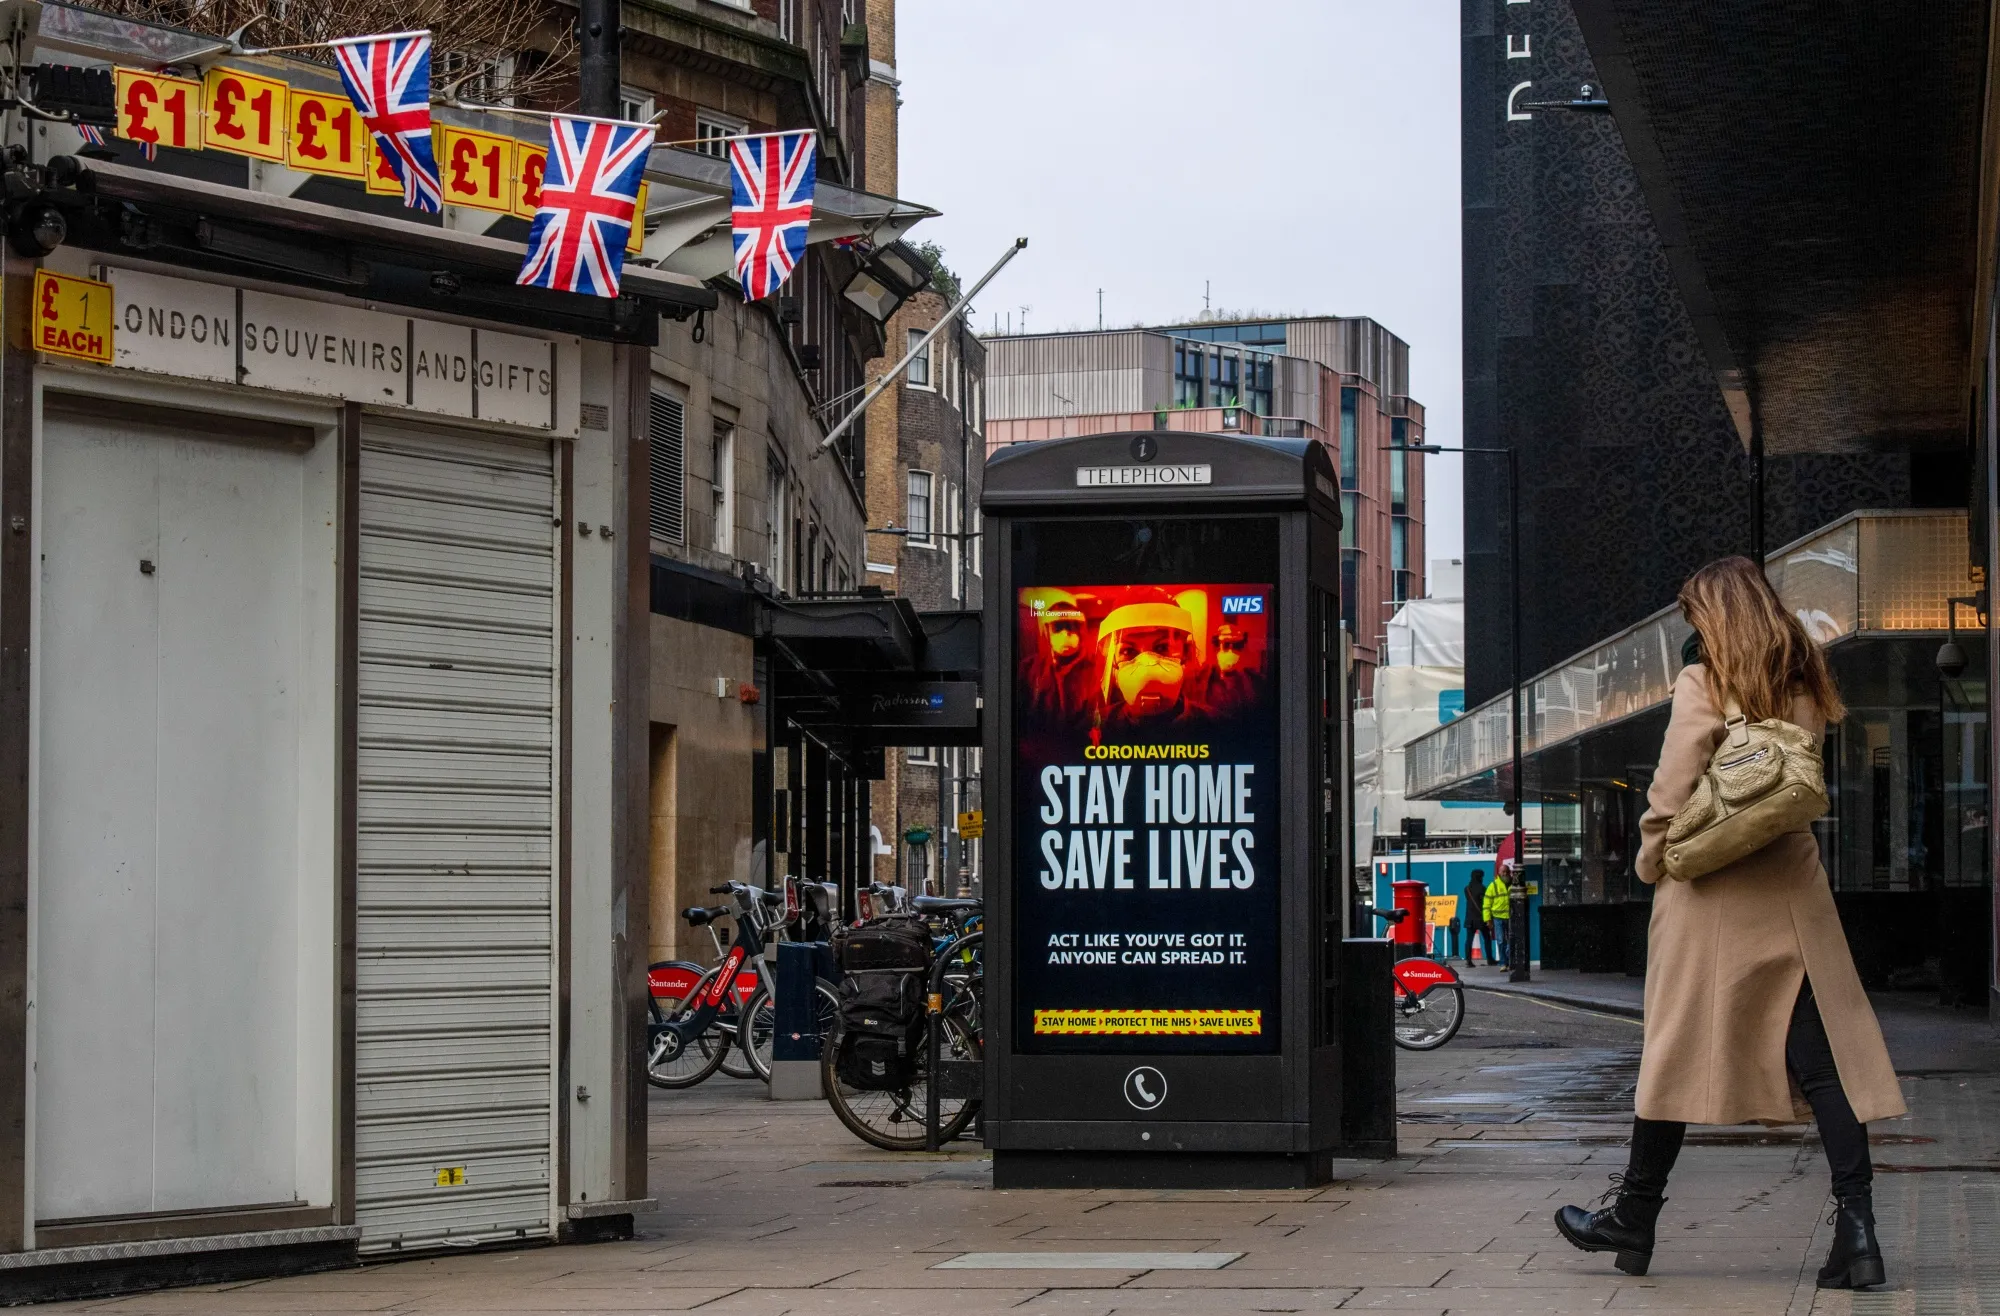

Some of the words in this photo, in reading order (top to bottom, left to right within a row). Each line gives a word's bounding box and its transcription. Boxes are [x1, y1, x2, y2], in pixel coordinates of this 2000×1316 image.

[124, 79, 186, 148] £1
[213, 77, 272, 146] £1
[296, 99, 352, 164] £1
[450, 137, 501, 199] £1
[43, 325, 103, 355] EACH
[114, 303, 230, 347] ONDON
[244, 322, 403, 374] SOUVENIRS
[416, 350, 467, 382] AND
[480, 360, 551, 396] GIFTS
[1084, 467, 1203, 485] TELEPHONE
[1223, 596, 1262, 613] NHS
[1084, 744, 1210, 759] CORONAVIRUS
[1040, 764, 1132, 825] STAY
[1145, 763, 1255, 825] HOME
[1040, 829, 1134, 890] SAVE
[1148, 828, 1255, 890] LIVES
[1048, 933, 1080, 947] ACT
[1084, 933, 1120, 947] LIKE
[1190, 933, 1225, 947] GOT
[1229, 933, 1247, 947] IT.
[1048, 951, 1117, 965] ANYONE
[1121, 951, 1157, 965] CAN
[1161, 951, 1225, 965] SPREAD
[1229, 951, 1247, 965] IT.
[650, 978, 688, 988] Santander
[1409, 970, 1442, 979] Santander
[1041, 1017, 1065, 1027] STAY
[1067, 1017, 1097, 1027] HOME
[1105, 1017, 1147, 1027] PROTECT
[1150, 1017, 1169, 1027] THE
[1171, 1017, 1192, 1027] NHS
[1199, 1017, 1224, 1027] SAVE
[1226, 1017, 1254, 1027] LIVES
